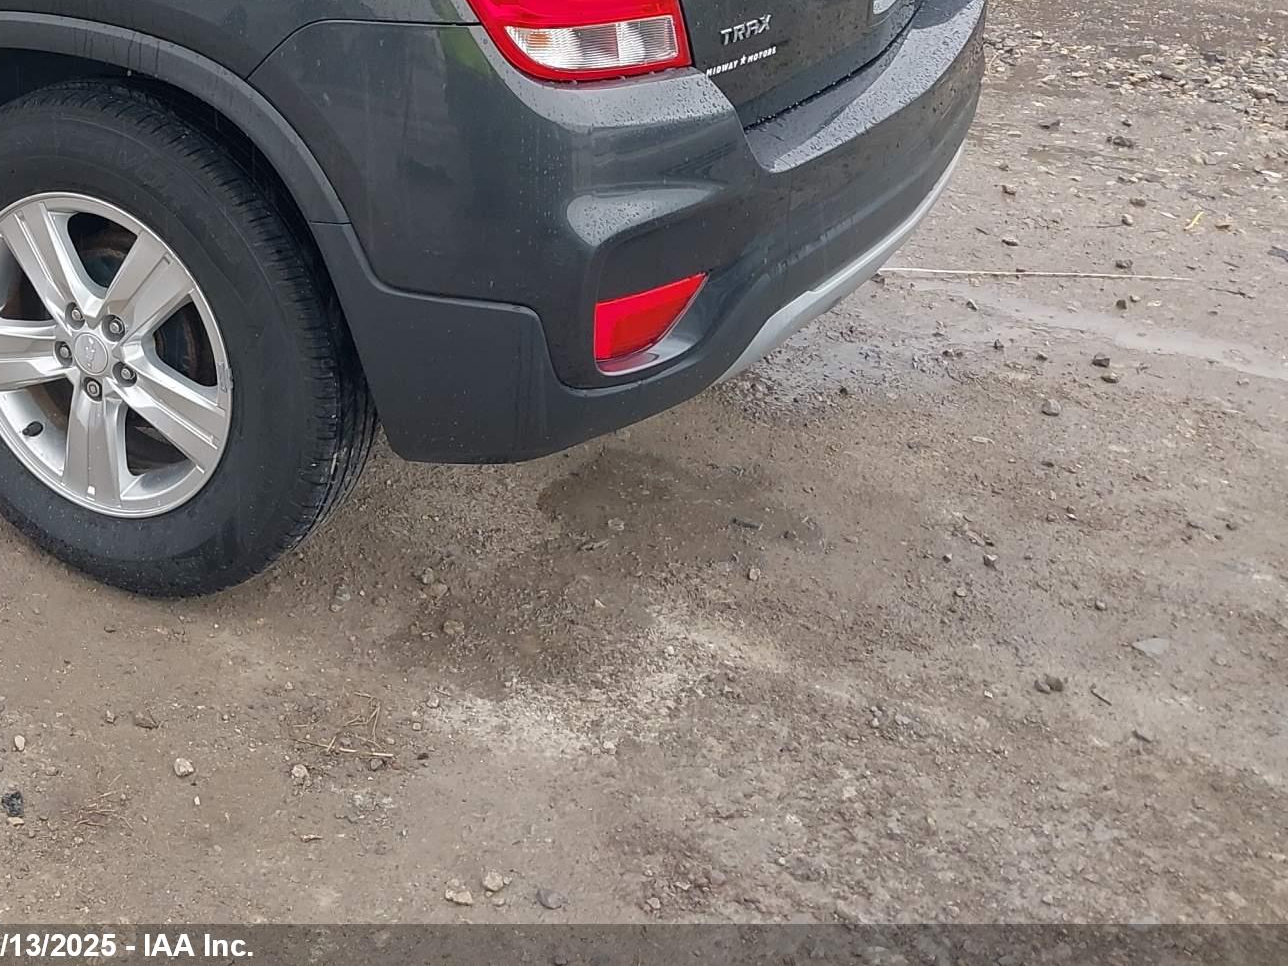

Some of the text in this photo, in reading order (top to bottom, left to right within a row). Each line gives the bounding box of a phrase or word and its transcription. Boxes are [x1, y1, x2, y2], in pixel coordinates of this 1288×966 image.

[720, 14, 771, 45] TRAX
[706, 46, 777, 76] MIDWAY MOTORS
